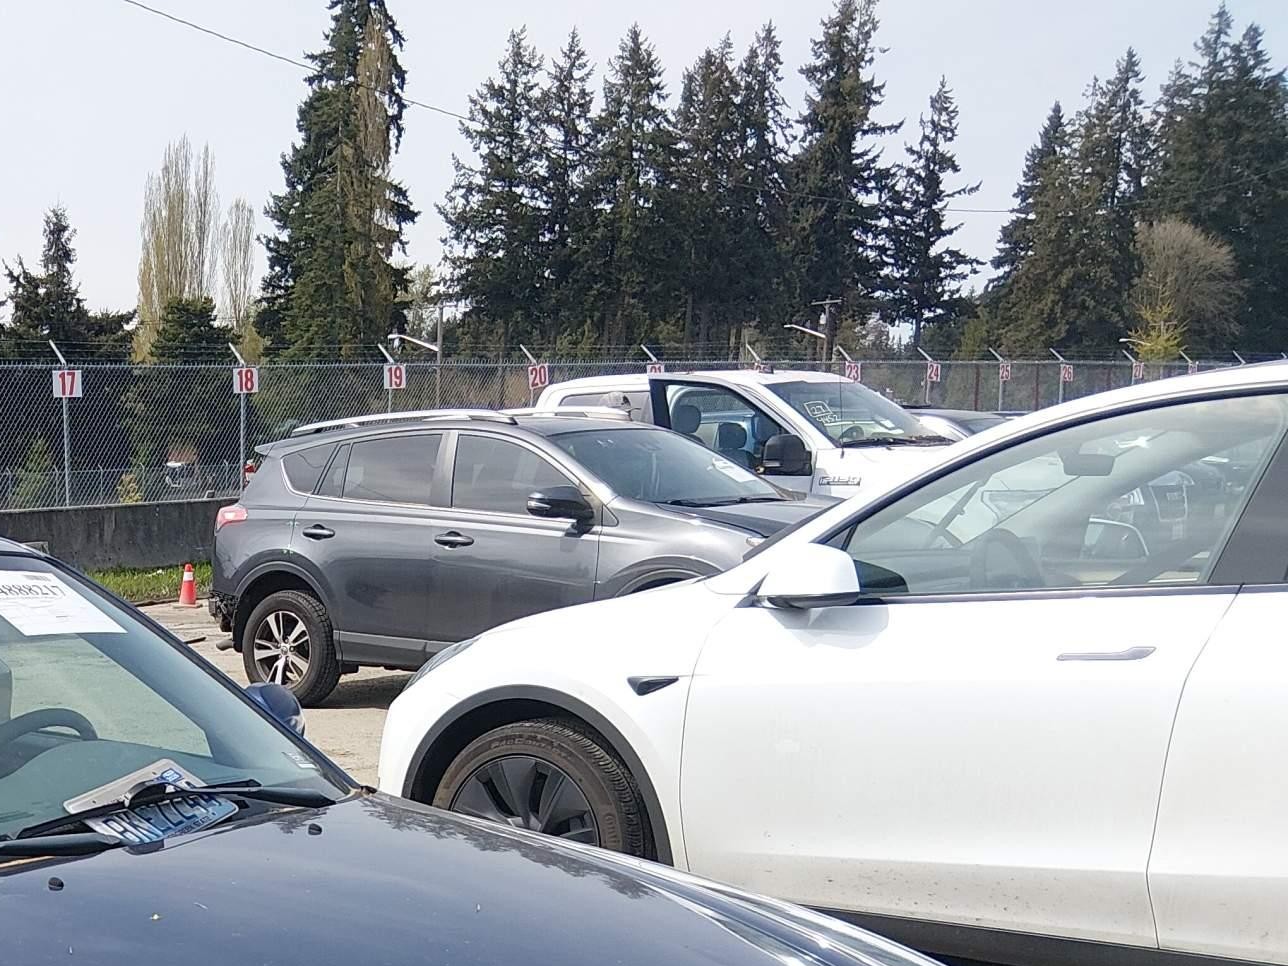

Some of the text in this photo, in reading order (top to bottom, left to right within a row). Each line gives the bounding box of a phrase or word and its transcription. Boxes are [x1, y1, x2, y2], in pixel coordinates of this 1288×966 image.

[238, 369, 254, 392] 18
[388, 366, 402, 387] 19
[530, 366, 546, 387] 20
[846, 364, 859, 380] 23
[928, 365, 939, 380] 24
[1001, 365, 1010, 380] 25
[1063, 366, 1072, 380] 26
[59, 372, 75, 395] 17
